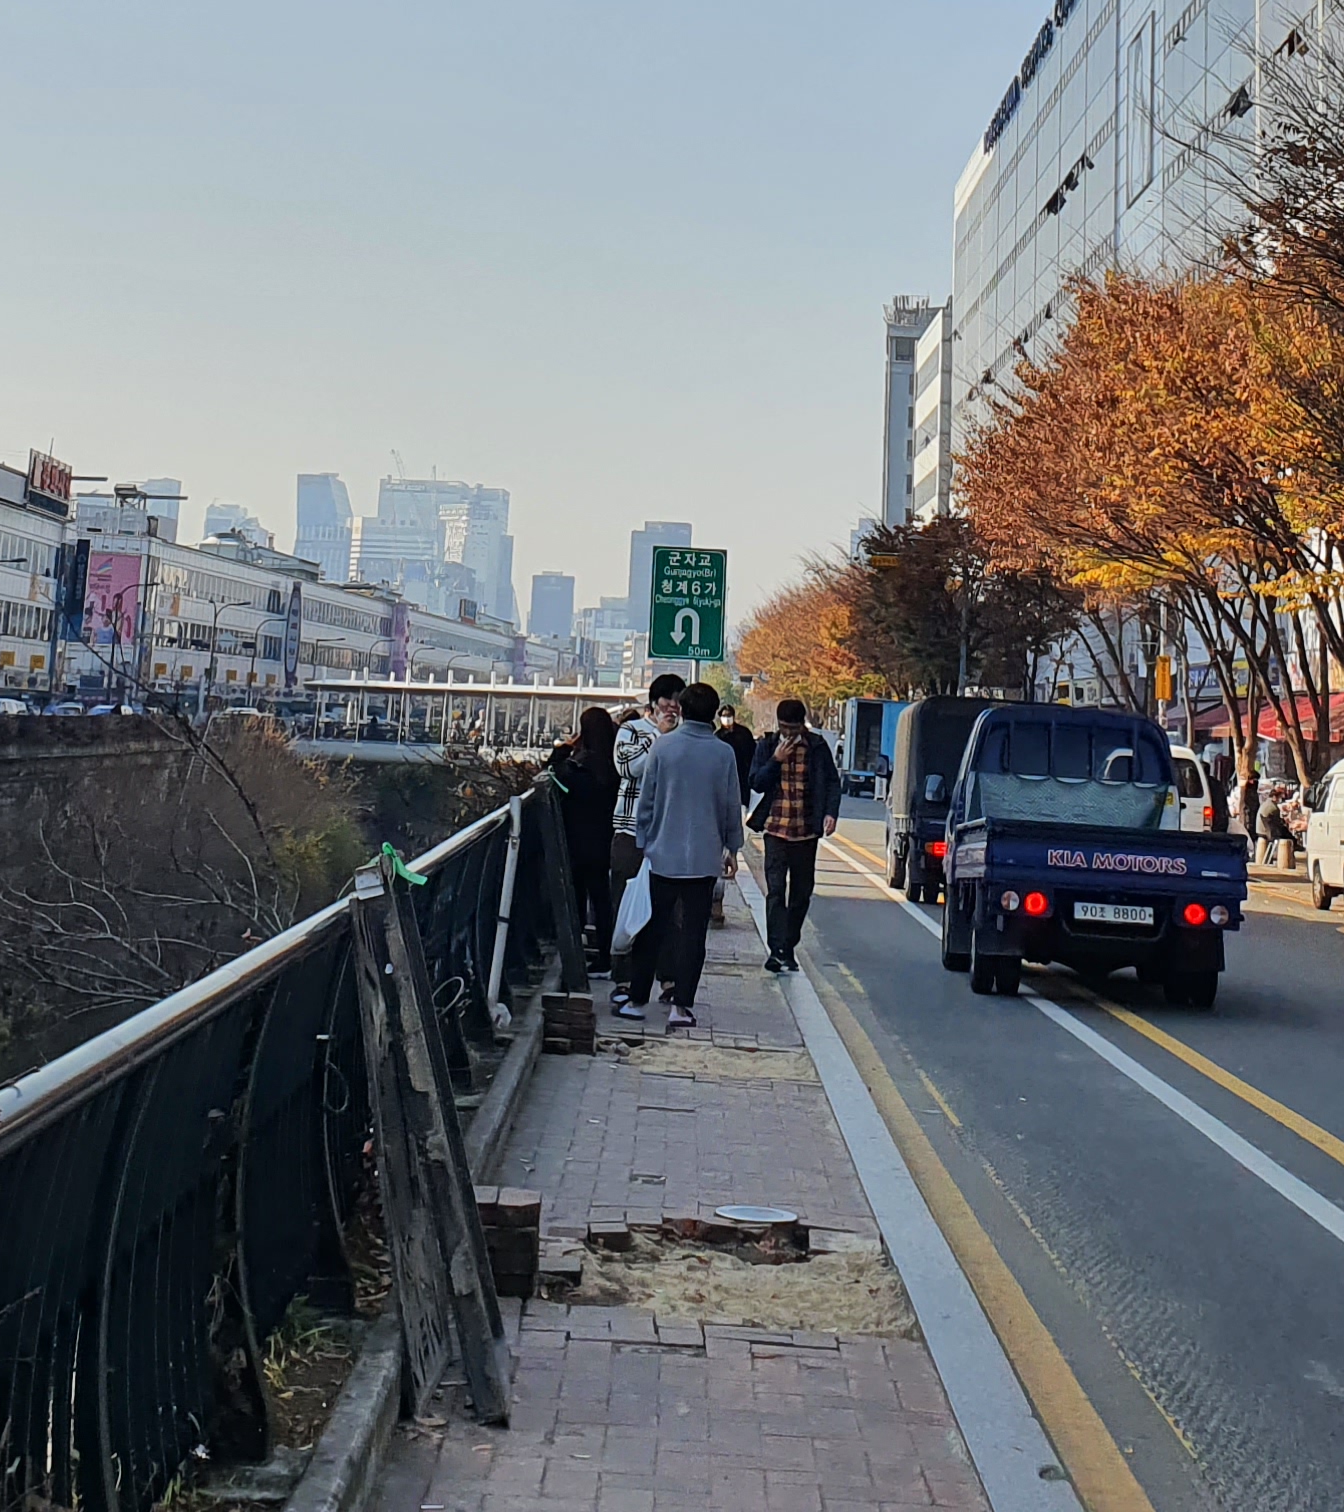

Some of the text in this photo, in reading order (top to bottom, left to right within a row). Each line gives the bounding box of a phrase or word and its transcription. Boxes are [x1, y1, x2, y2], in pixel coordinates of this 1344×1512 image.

[668, 551, 712, 567] 군자교
[661, 579, 717, 596] 청계6가
[1047, 849, 1187, 875] KIA MOTORS
[1113, 907, 1147, 921] 8800
